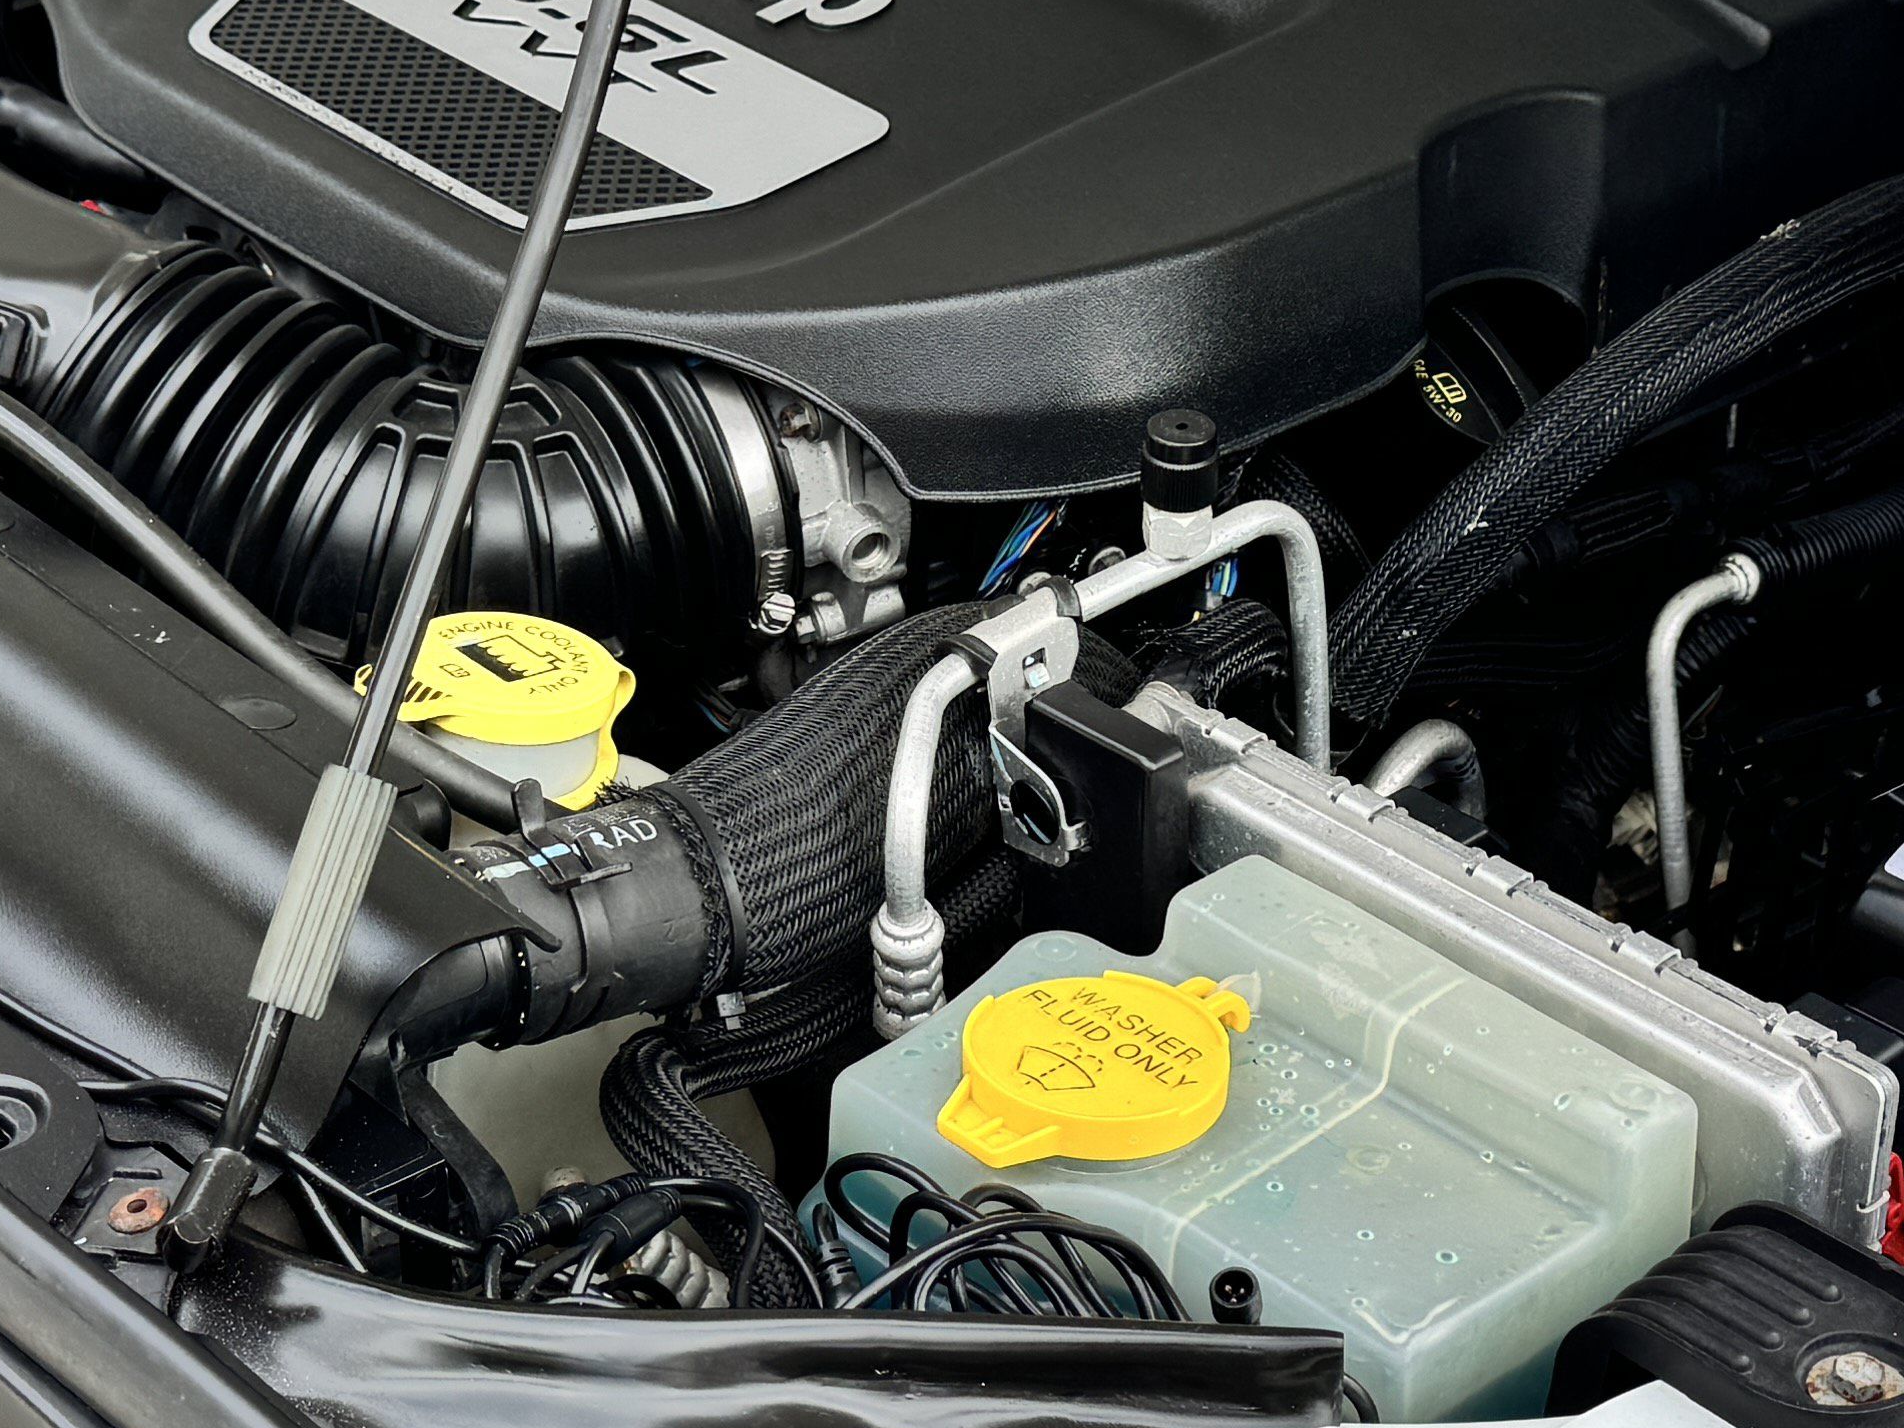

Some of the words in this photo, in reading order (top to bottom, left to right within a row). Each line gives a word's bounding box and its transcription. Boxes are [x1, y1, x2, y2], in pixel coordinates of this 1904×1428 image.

[1423, 384, 1462, 424] 5W-30
[438, 621, 516, 640] ENGINE
[525, 625, 590, 675] COOLANT
[528, 676, 580, 696] ONLY
[1023, 988, 1112, 1044] FLUID
[1113, 1041, 1200, 1091] ONLY
[1070, 985, 1204, 1067] WASHER
